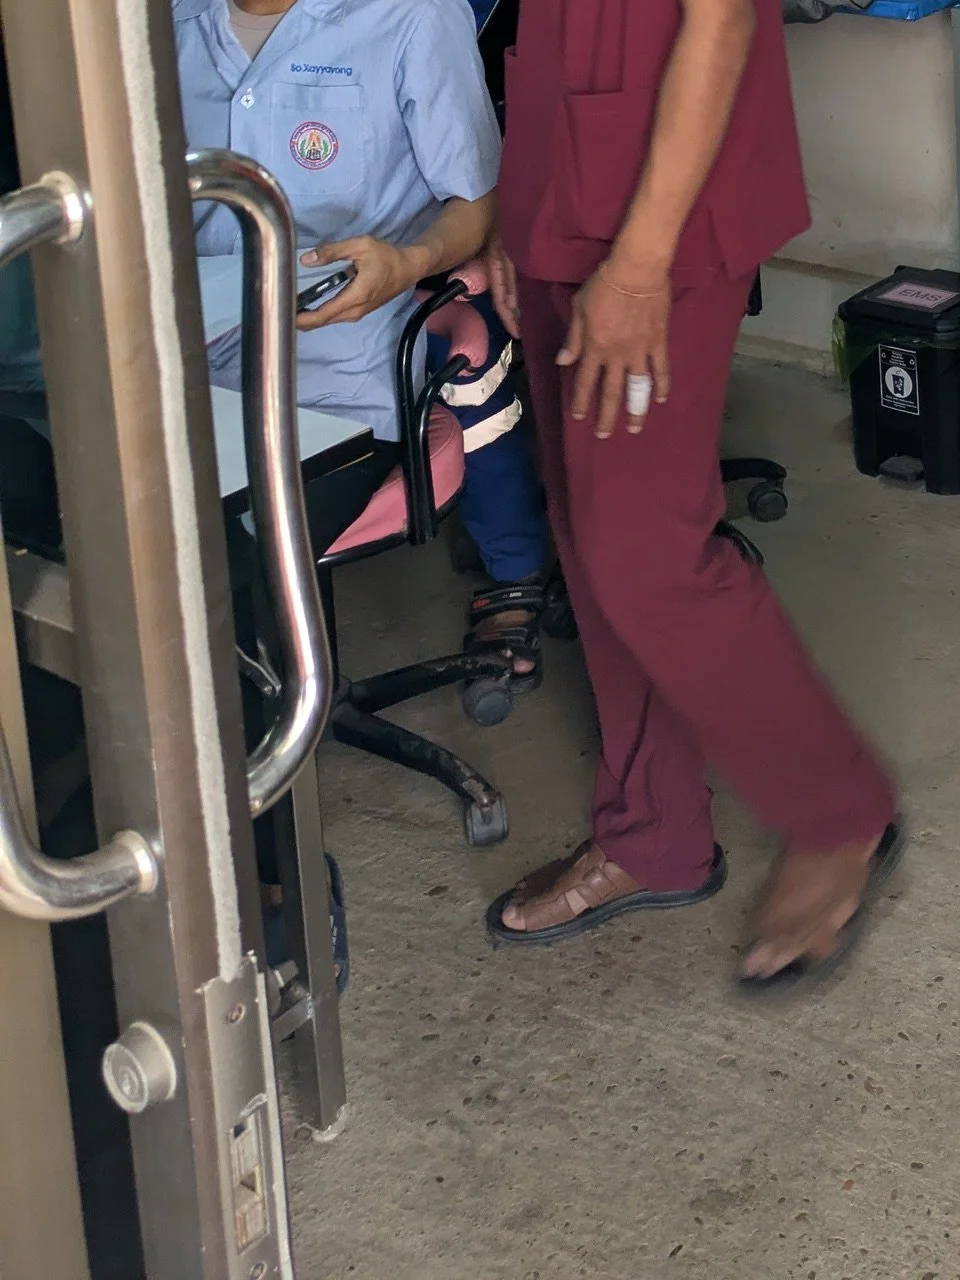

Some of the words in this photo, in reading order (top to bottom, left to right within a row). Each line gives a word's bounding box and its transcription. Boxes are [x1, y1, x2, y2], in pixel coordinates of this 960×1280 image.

[290, 63, 303, 73] So
[302, 63, 353, 76] Xayyavong
[898, 288, 942, 303] EMS
